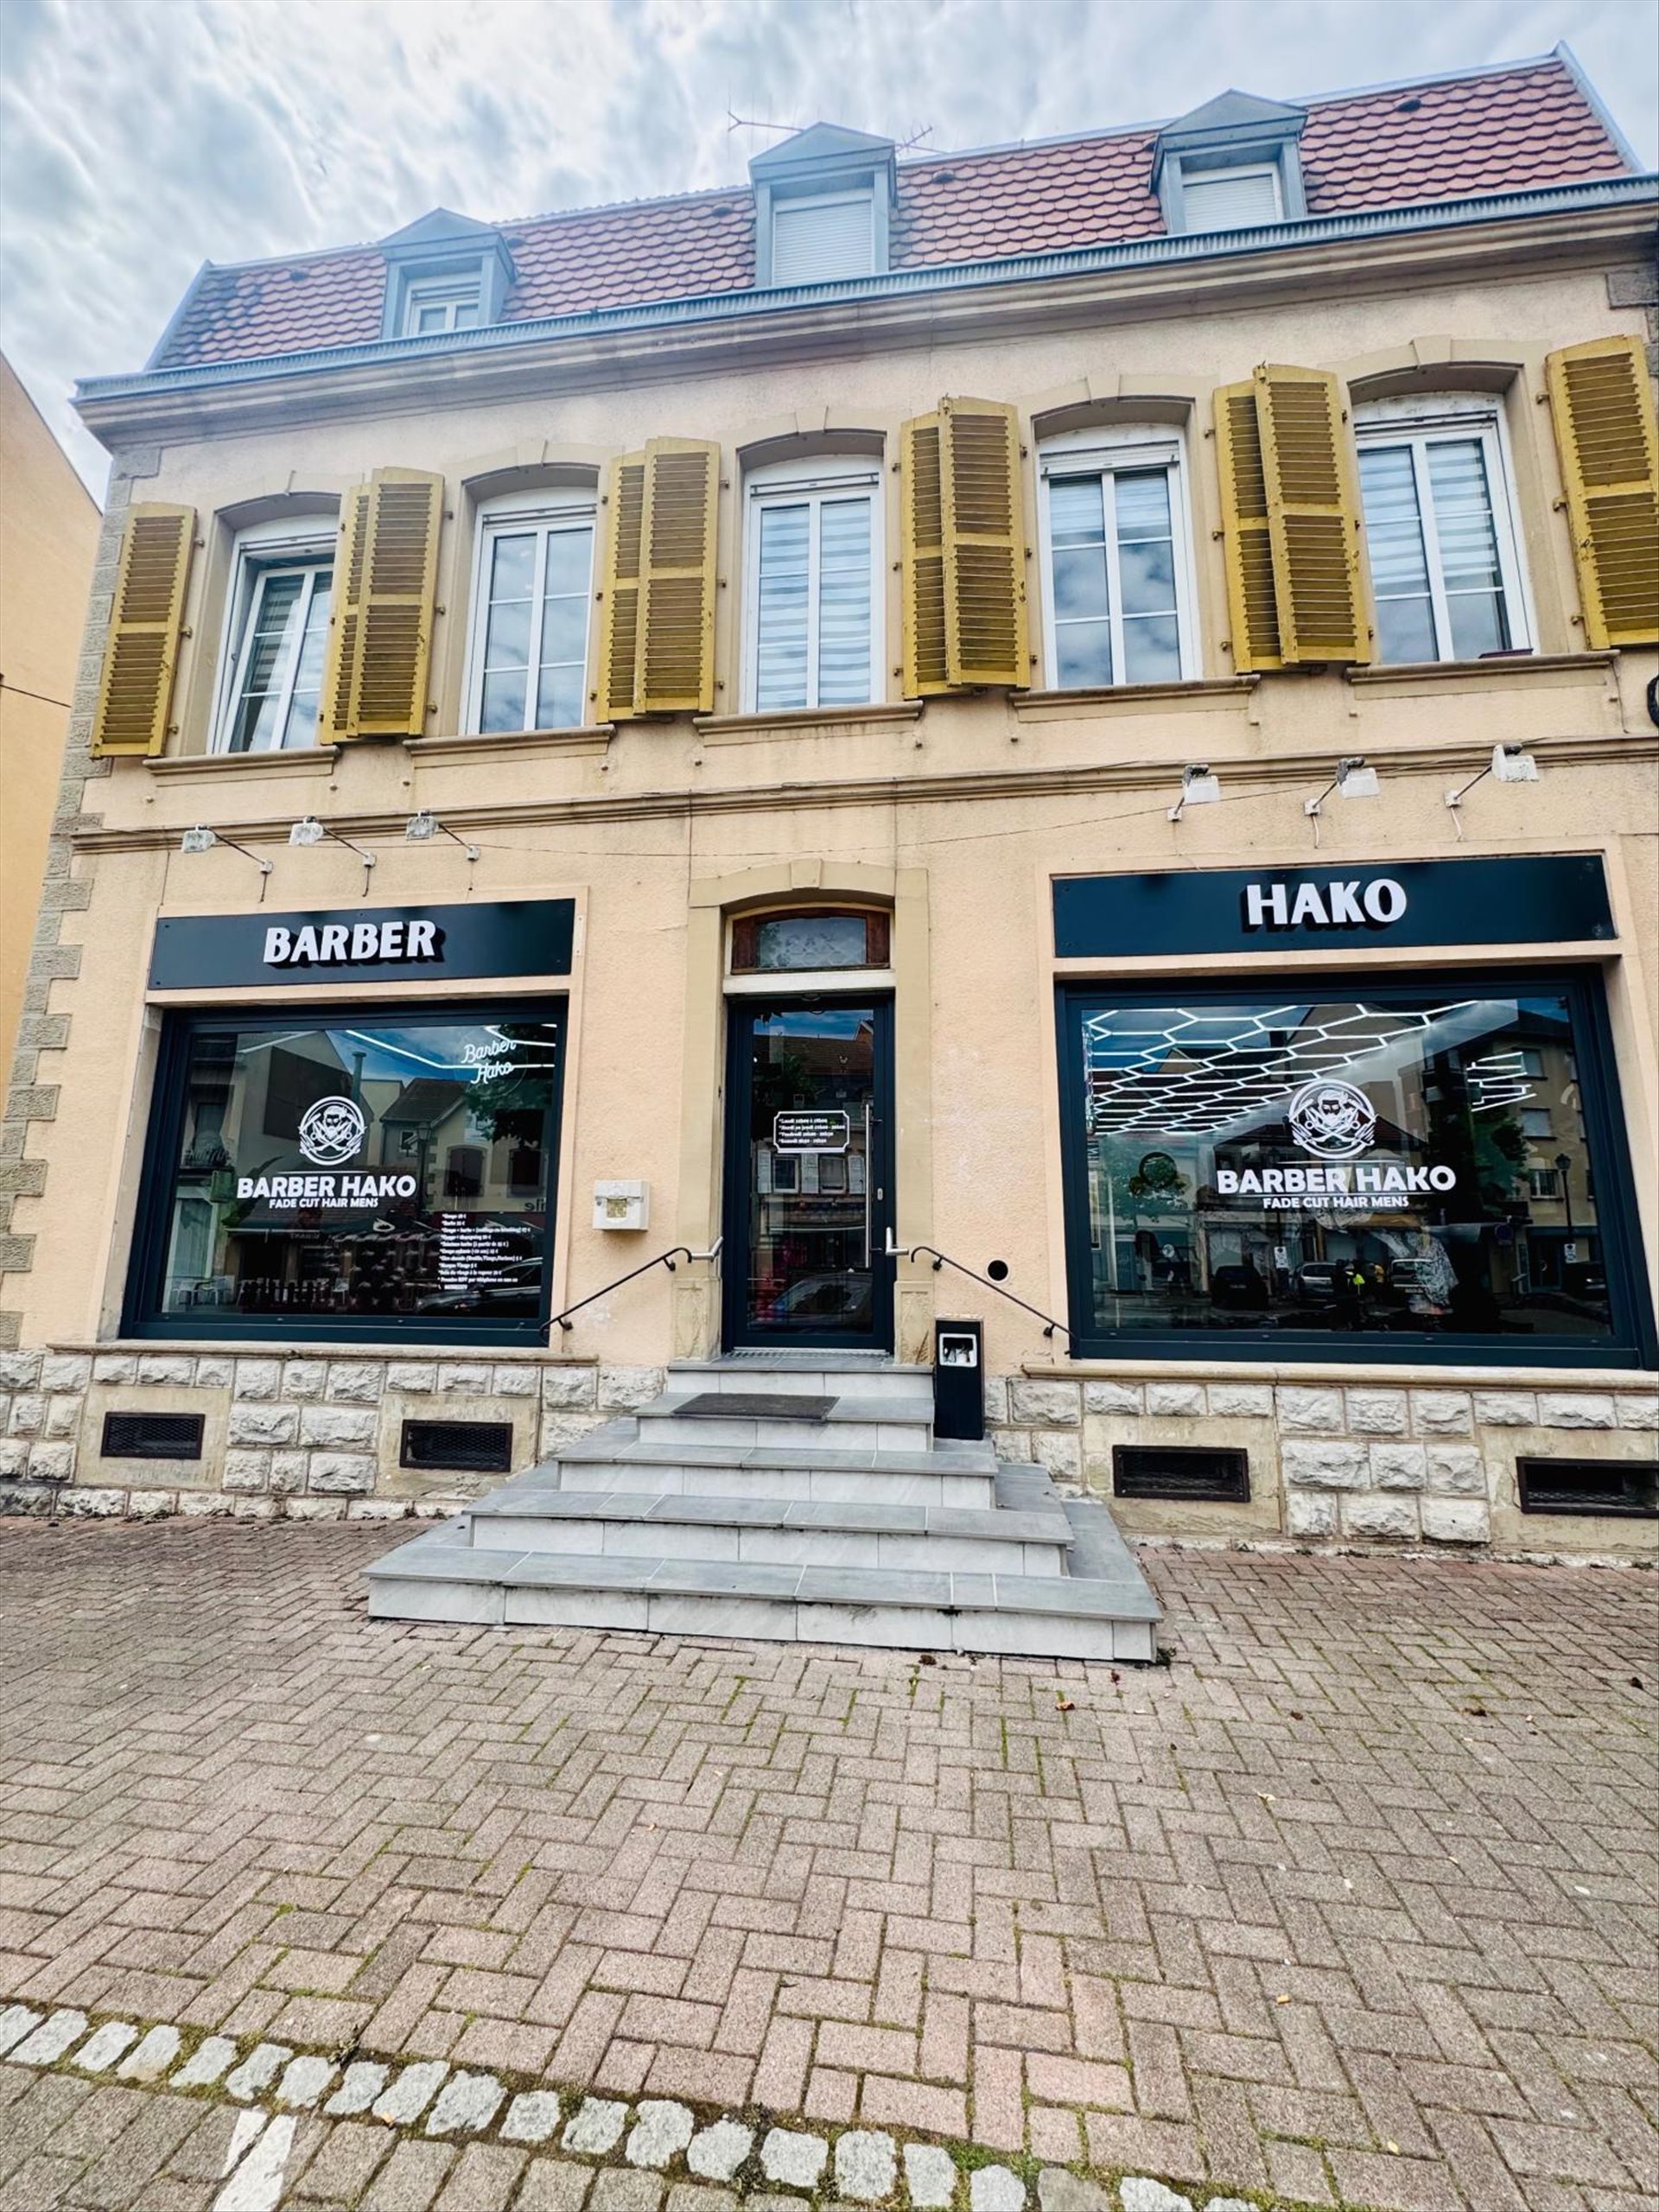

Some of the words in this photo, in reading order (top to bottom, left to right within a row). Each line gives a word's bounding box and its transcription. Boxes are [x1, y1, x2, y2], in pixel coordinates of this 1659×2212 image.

[1247, 879, 1407, 925] HAKO
[264, 920, 436, 963] BARBER
[461, 1040, 517, 1063] Barber
[470, 1061, 515, 1084] Hako
[237, 1177, 336, 1198] BARBER
[340, 1175, 416, 1198] HAKO
[1217, 1167, 1349, 1194] BARBER
[1356, 1166, 1456, 1191] HAKO
[269, 1198, 296, 1209] FADE
[299, 1198, 320, 1208] CUT
[321, 1198, 347, 1207] HAIR
[350, 1197, 378, 1207] MENS
[1263, 1197, 1300, 1209] FADE
[1302, 1197, 1331, 1208] CUT
[1333, 1197, 1368, 1208] HAIR
[1371, 1196, 1409, 1207] MENS
